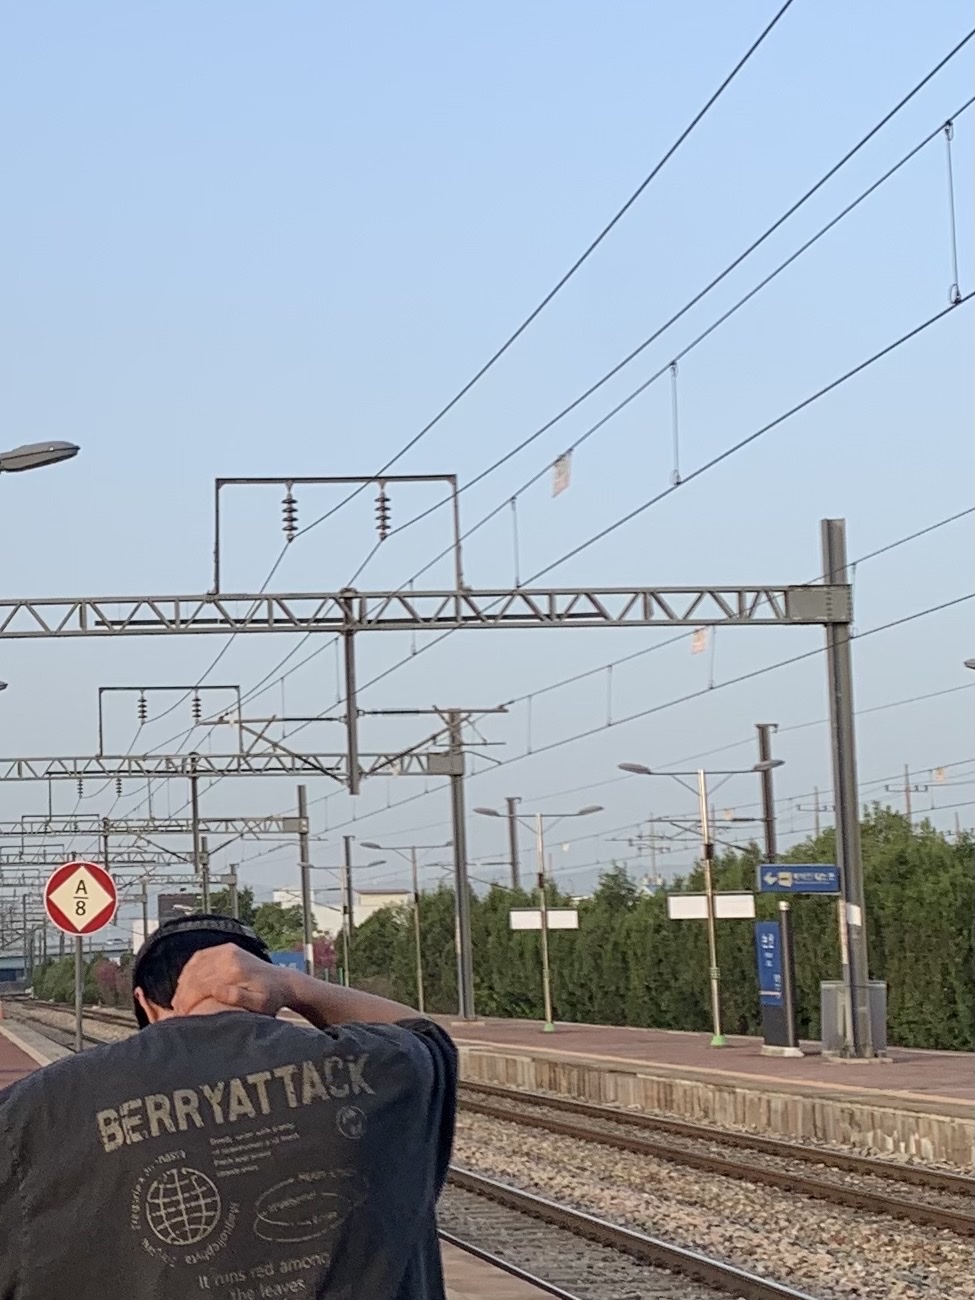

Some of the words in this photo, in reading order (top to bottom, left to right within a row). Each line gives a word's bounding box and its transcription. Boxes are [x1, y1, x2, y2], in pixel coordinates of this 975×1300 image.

[74, 879, 88, 895] A
[75, 900, 86, 916] 8
[96, 1053, 376, 1153] BERRYATTACK
